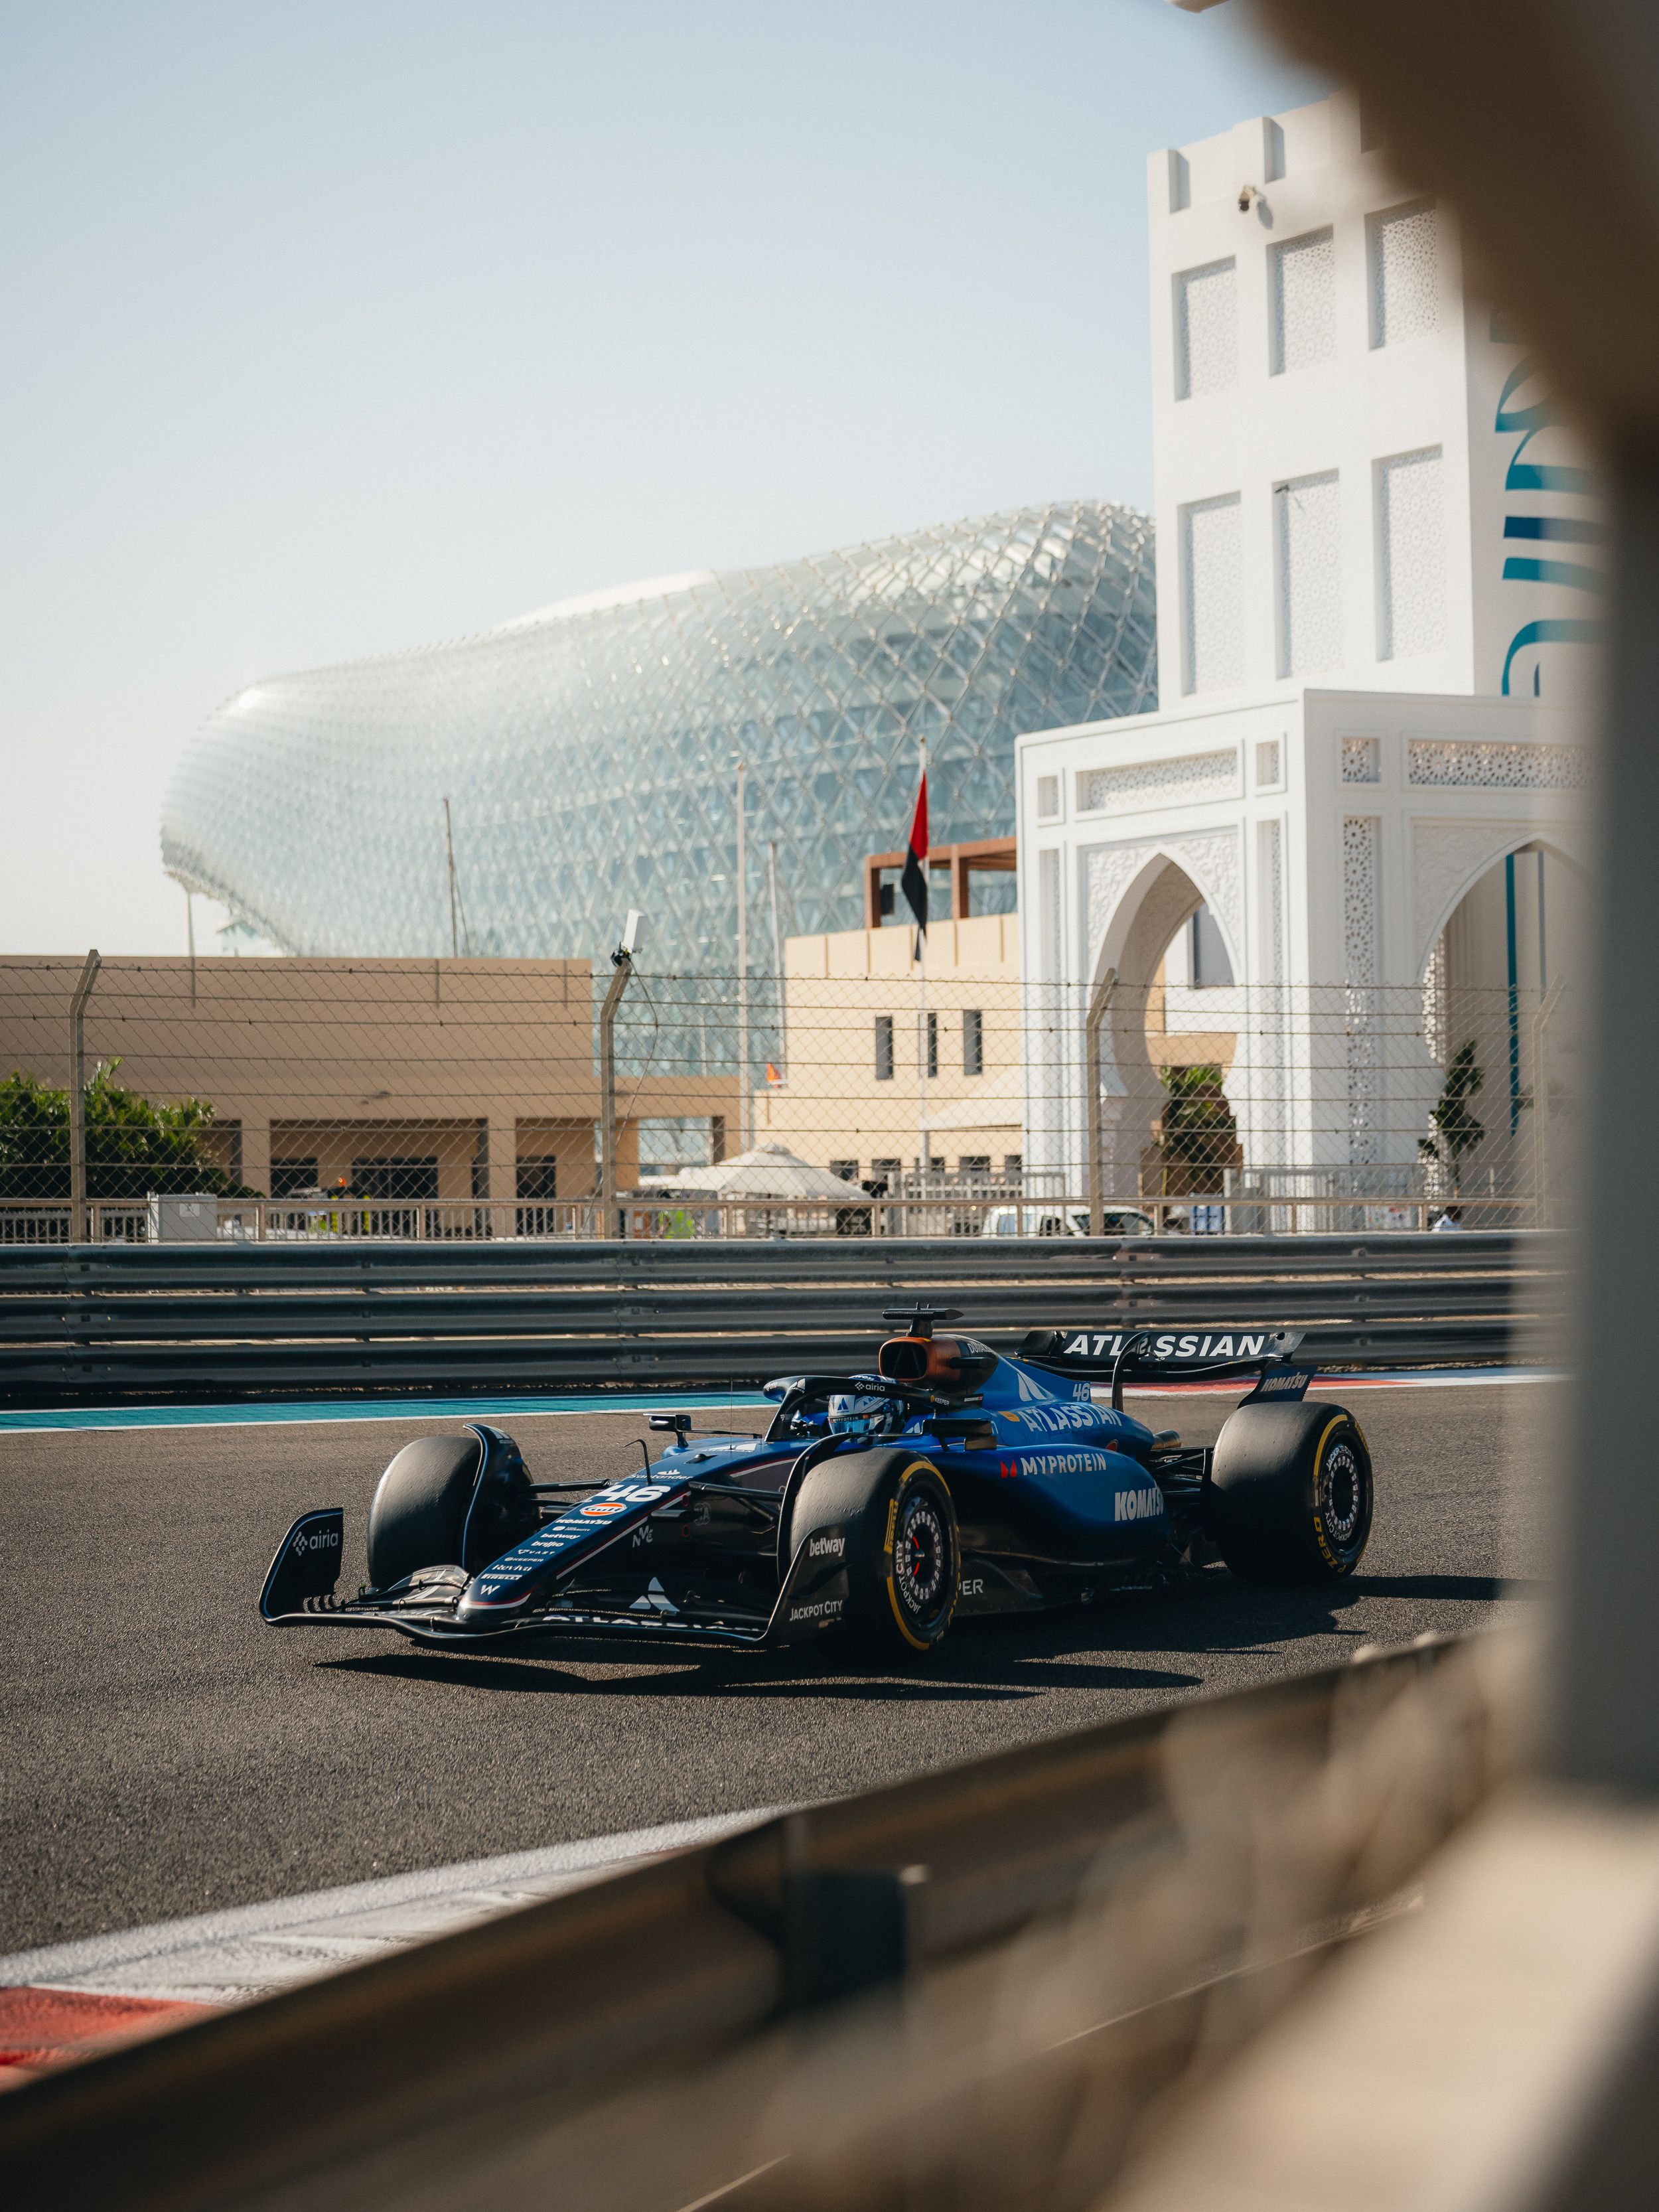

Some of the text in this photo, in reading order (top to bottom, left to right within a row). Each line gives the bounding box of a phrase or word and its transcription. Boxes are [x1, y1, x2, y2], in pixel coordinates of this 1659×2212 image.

[1064, 1335, 1265, 1357] ATLSSIAN
[865, 1383, 885, 1392] airia
[1072, 1382, 1090, 1402] 46
[1260, 1372, 1309, 1392] KOMATSU
[1017, 1404, 1122, 1432] ATLASSIAN
[1020, 1453, 1107, 1476] MYPROTEIN
[596, 1485, 671, 1502] 46
[309, 1528, 338, 1550] airia
[810, 1538, 845, 1556] betway
